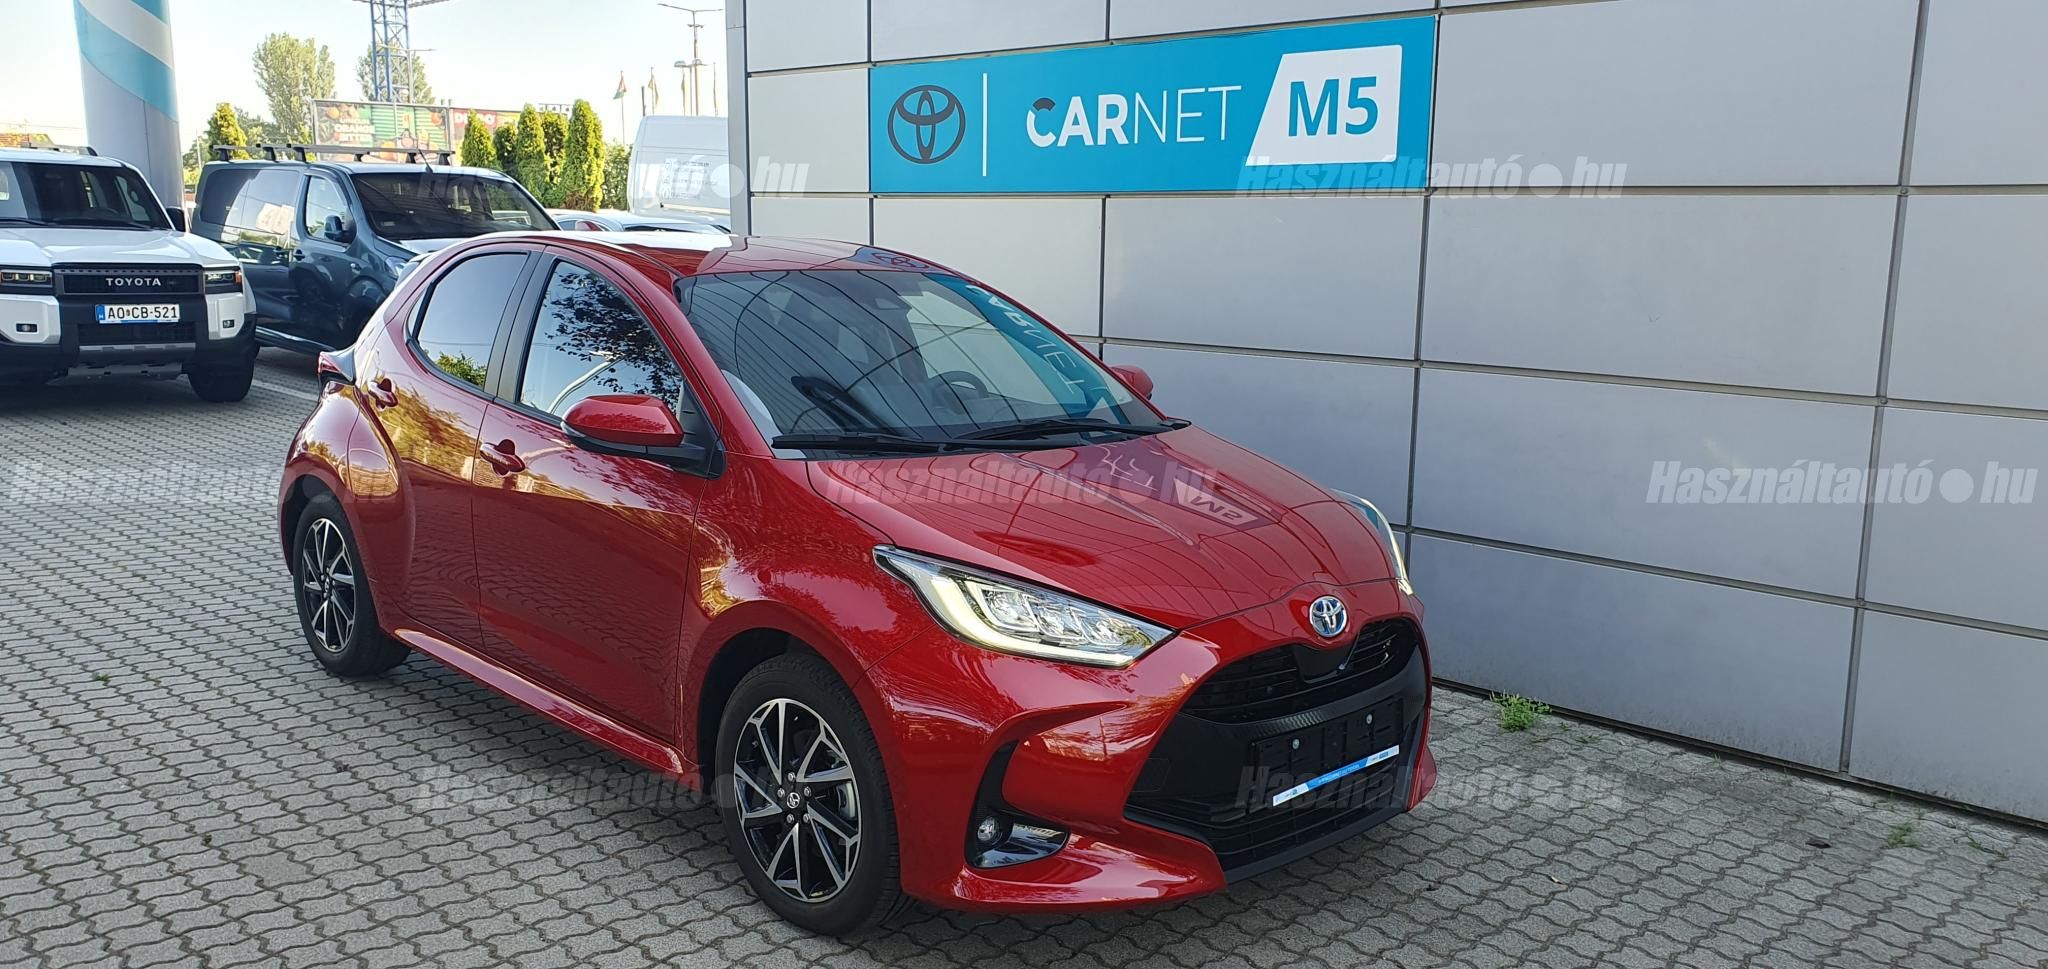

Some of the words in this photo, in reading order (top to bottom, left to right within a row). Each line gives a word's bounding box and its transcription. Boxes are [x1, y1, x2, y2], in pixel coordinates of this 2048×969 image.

[1026, 86, 1242, 148] CARNET
[1288, 76, 1380, 138] M5
[105, 278, 162, 287] TOYOTA
